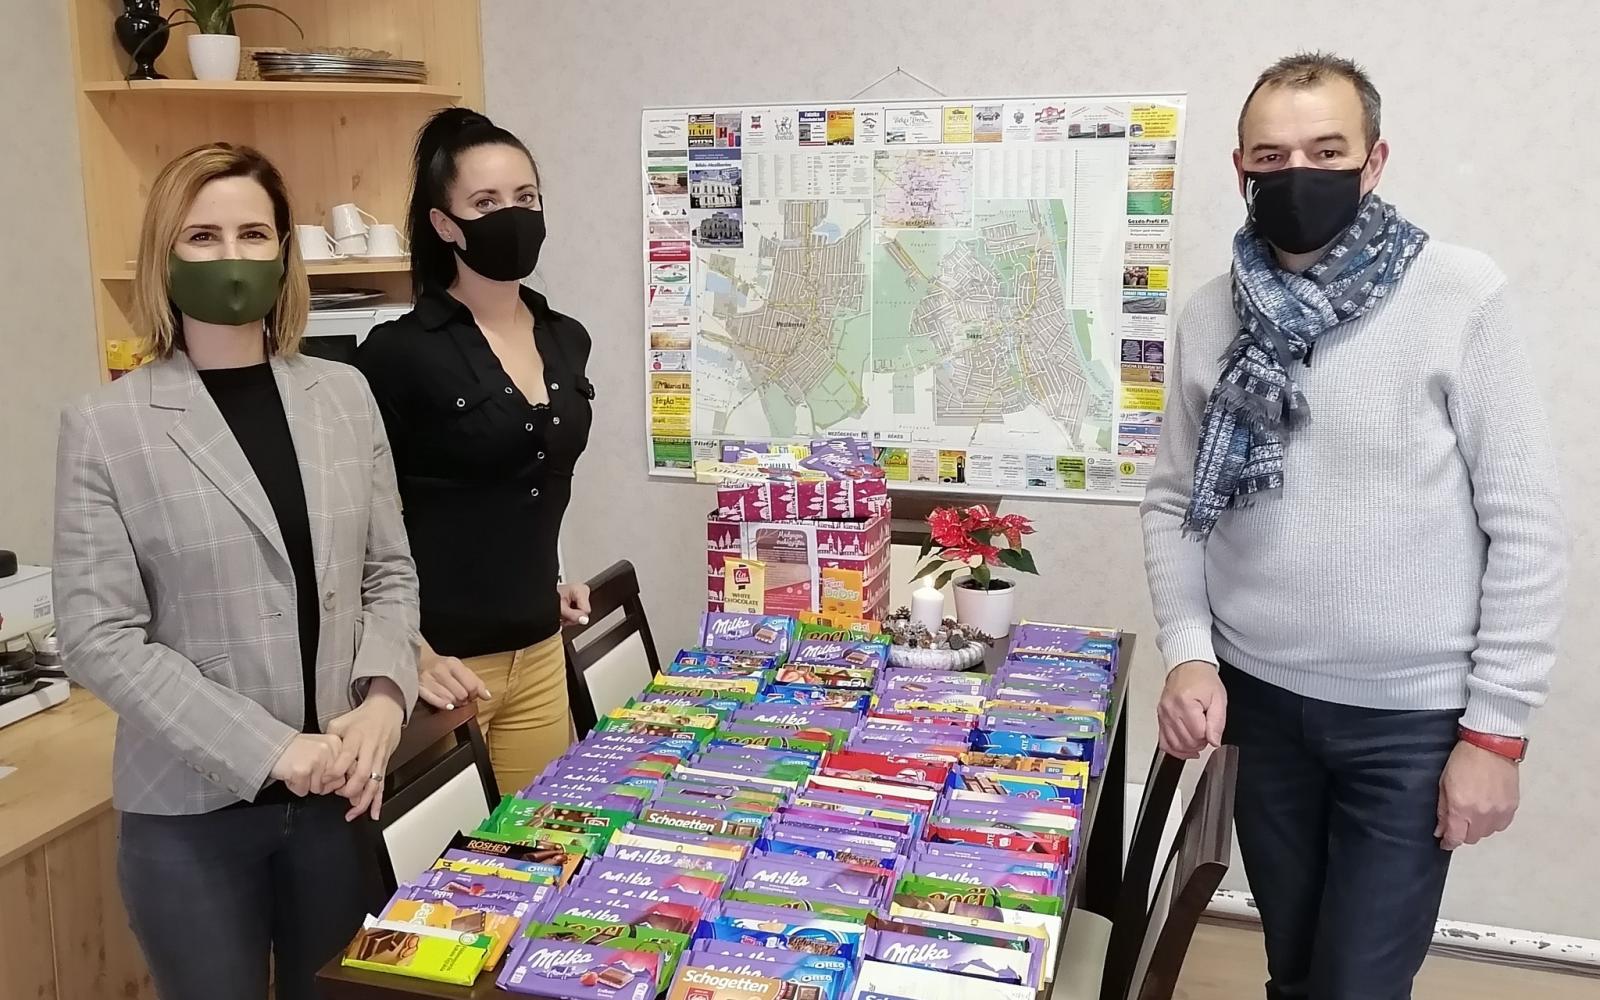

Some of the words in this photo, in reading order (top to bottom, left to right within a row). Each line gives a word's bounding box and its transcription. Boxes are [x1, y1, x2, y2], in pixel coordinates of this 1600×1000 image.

[712, 616, 751, 635] Milka
[801, 643, 843, 658] Milka
[753, 714, 810, 726] Milka
[647, 811, 717, 832] Schogetten
[466, 839, 511, 854] ROSHEN
[616, 849, 674, 865] Milka
[599, 871, 653, 887] Milka
[751, 869, 811, 887] Milka
[527, 948, 595, 970] Milka
[883, 942, 952, 963] Milka
[682, 969, 770, 993] Schogetten
